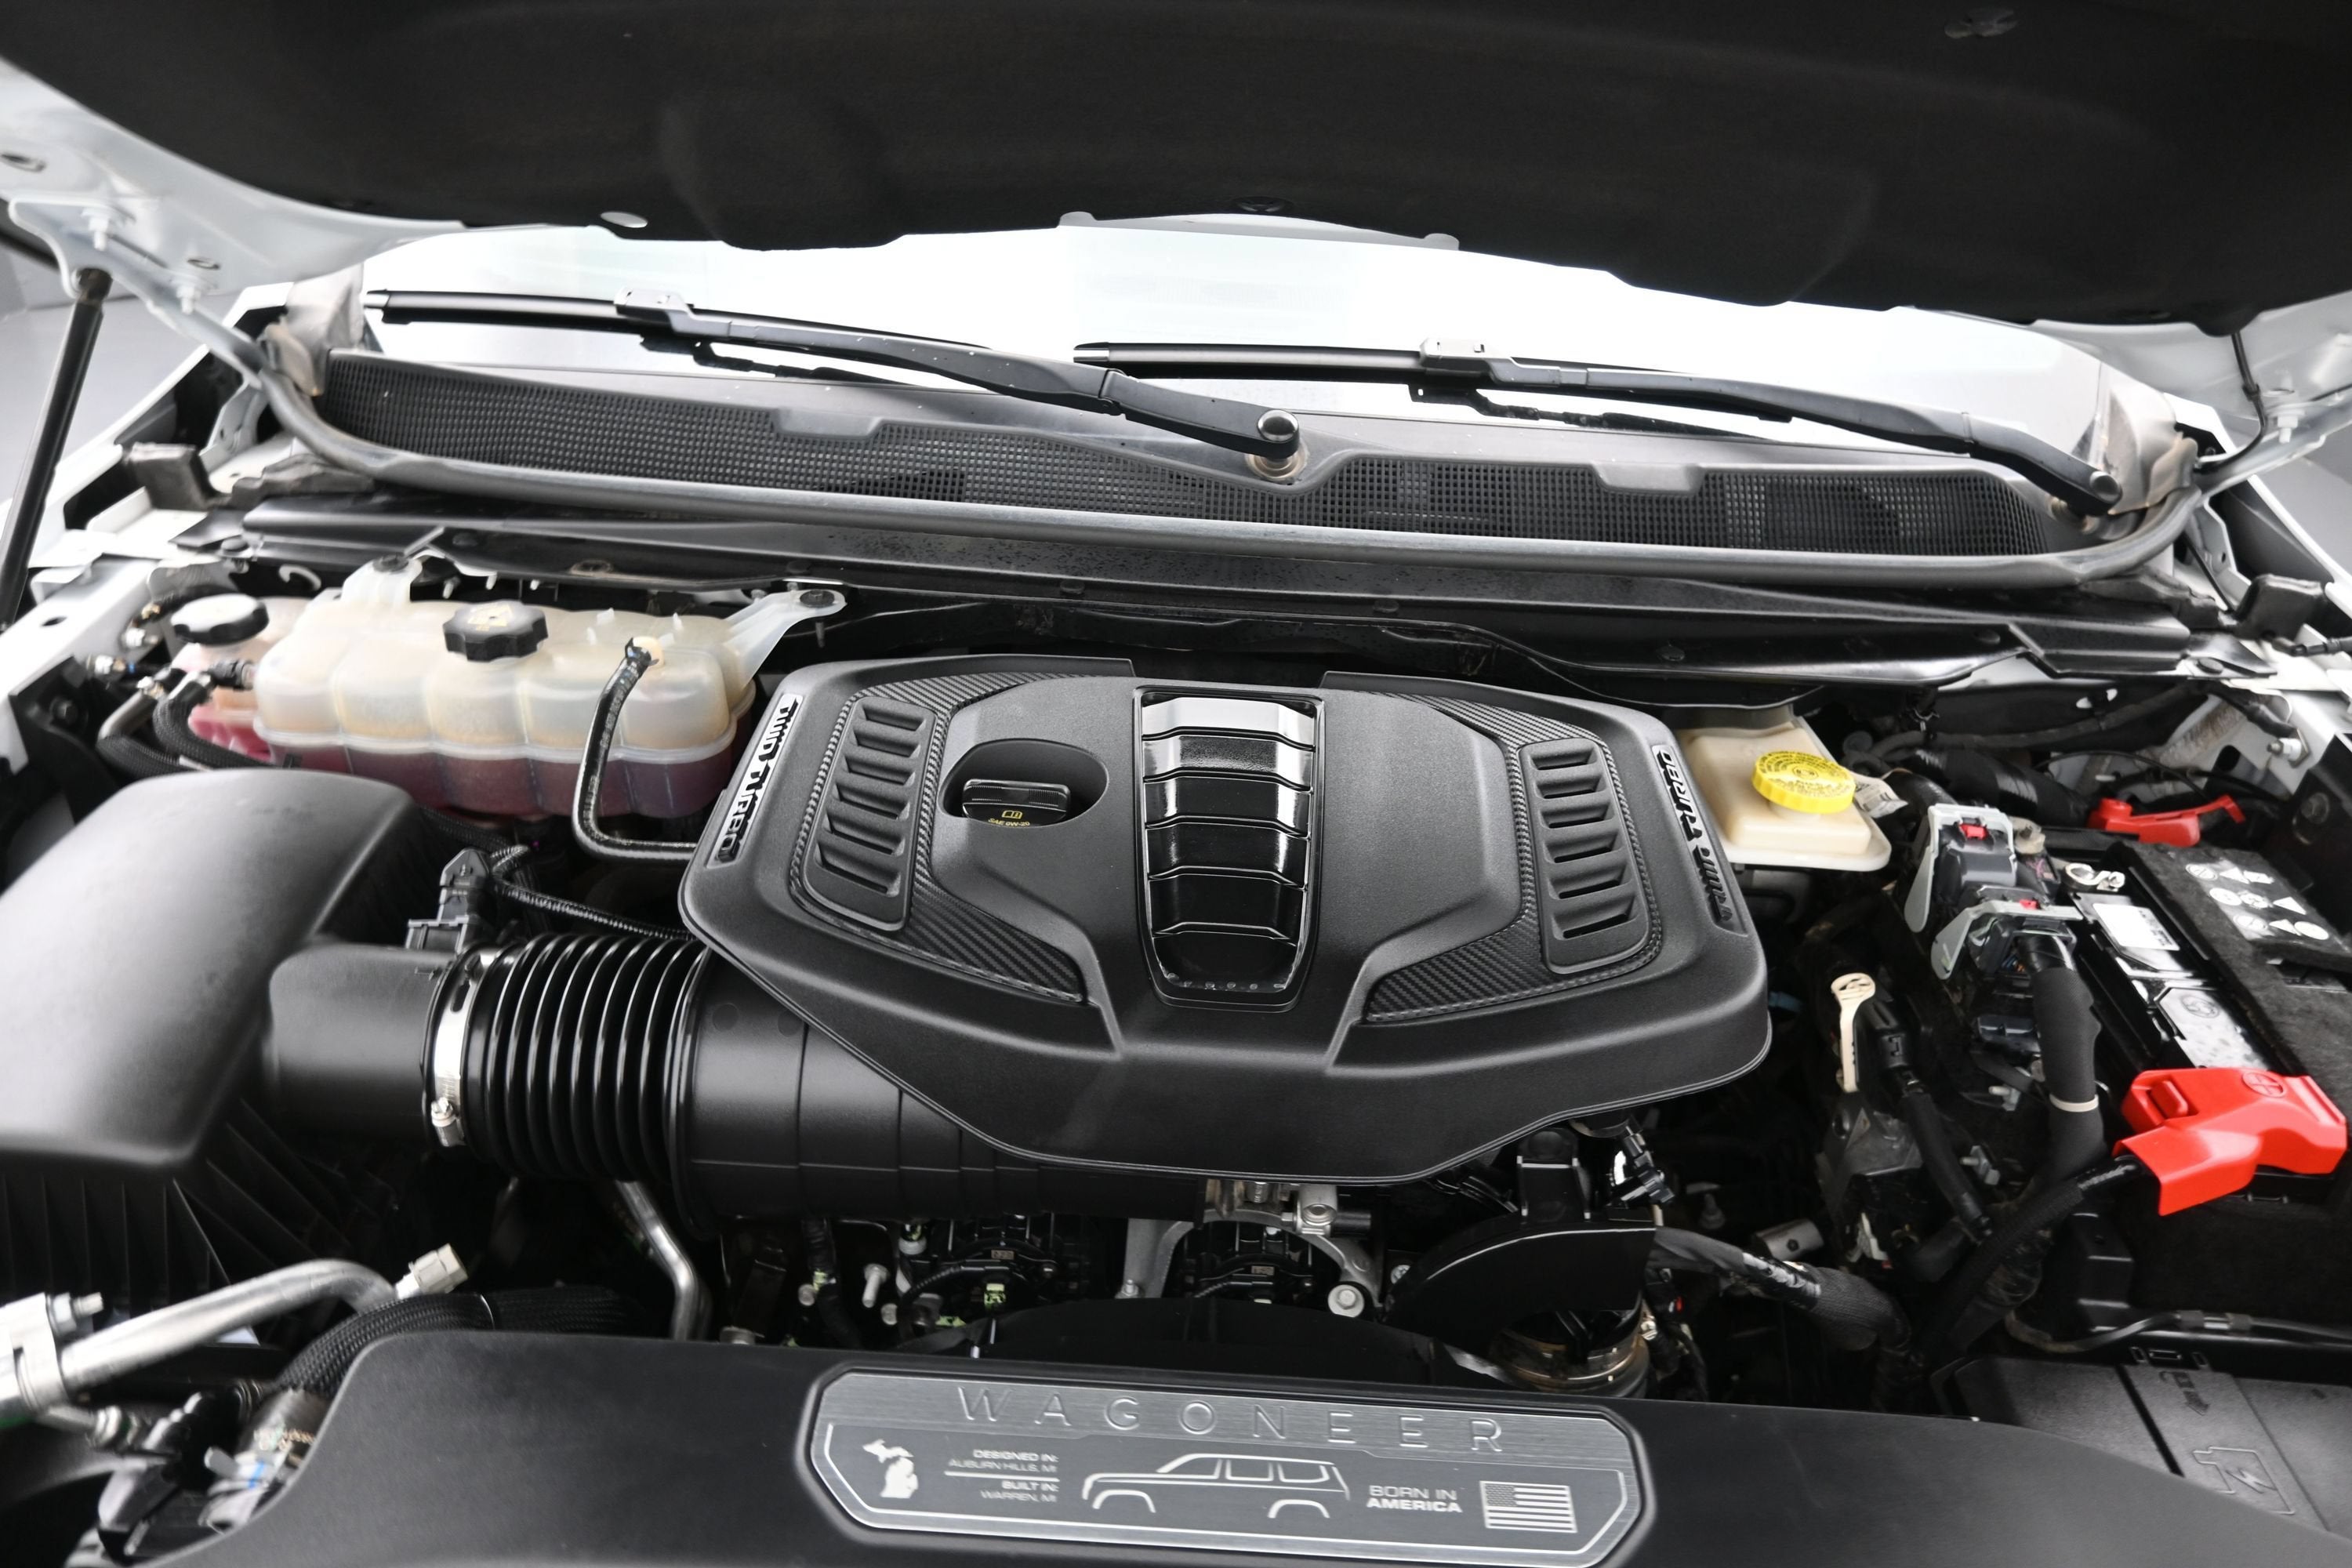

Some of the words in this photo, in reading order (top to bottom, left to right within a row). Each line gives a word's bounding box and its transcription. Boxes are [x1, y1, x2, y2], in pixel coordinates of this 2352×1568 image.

[1657, 750, 1702, 841] TURBO
[717, 763, 770, 862] TURBO
[988, 818, 1005, 826] SAE
[956, 1385, 1504, 1452] WAGONEER
[972, 1449, 1039, 1461] DESIGNED
[948, 1458, 1001, 1469] AUBURN
[1041, 1464, 1057, 1472] MI
[1001, 1480, 1039, 1490] BUILT
[1040, 1494, 1057, 1502] MI
[1369, 1485, 1430, 1499] BORN
[1436, 1489, 1458, 1500] IN
[1366, 1497, 1463, 1513] AMERICA
